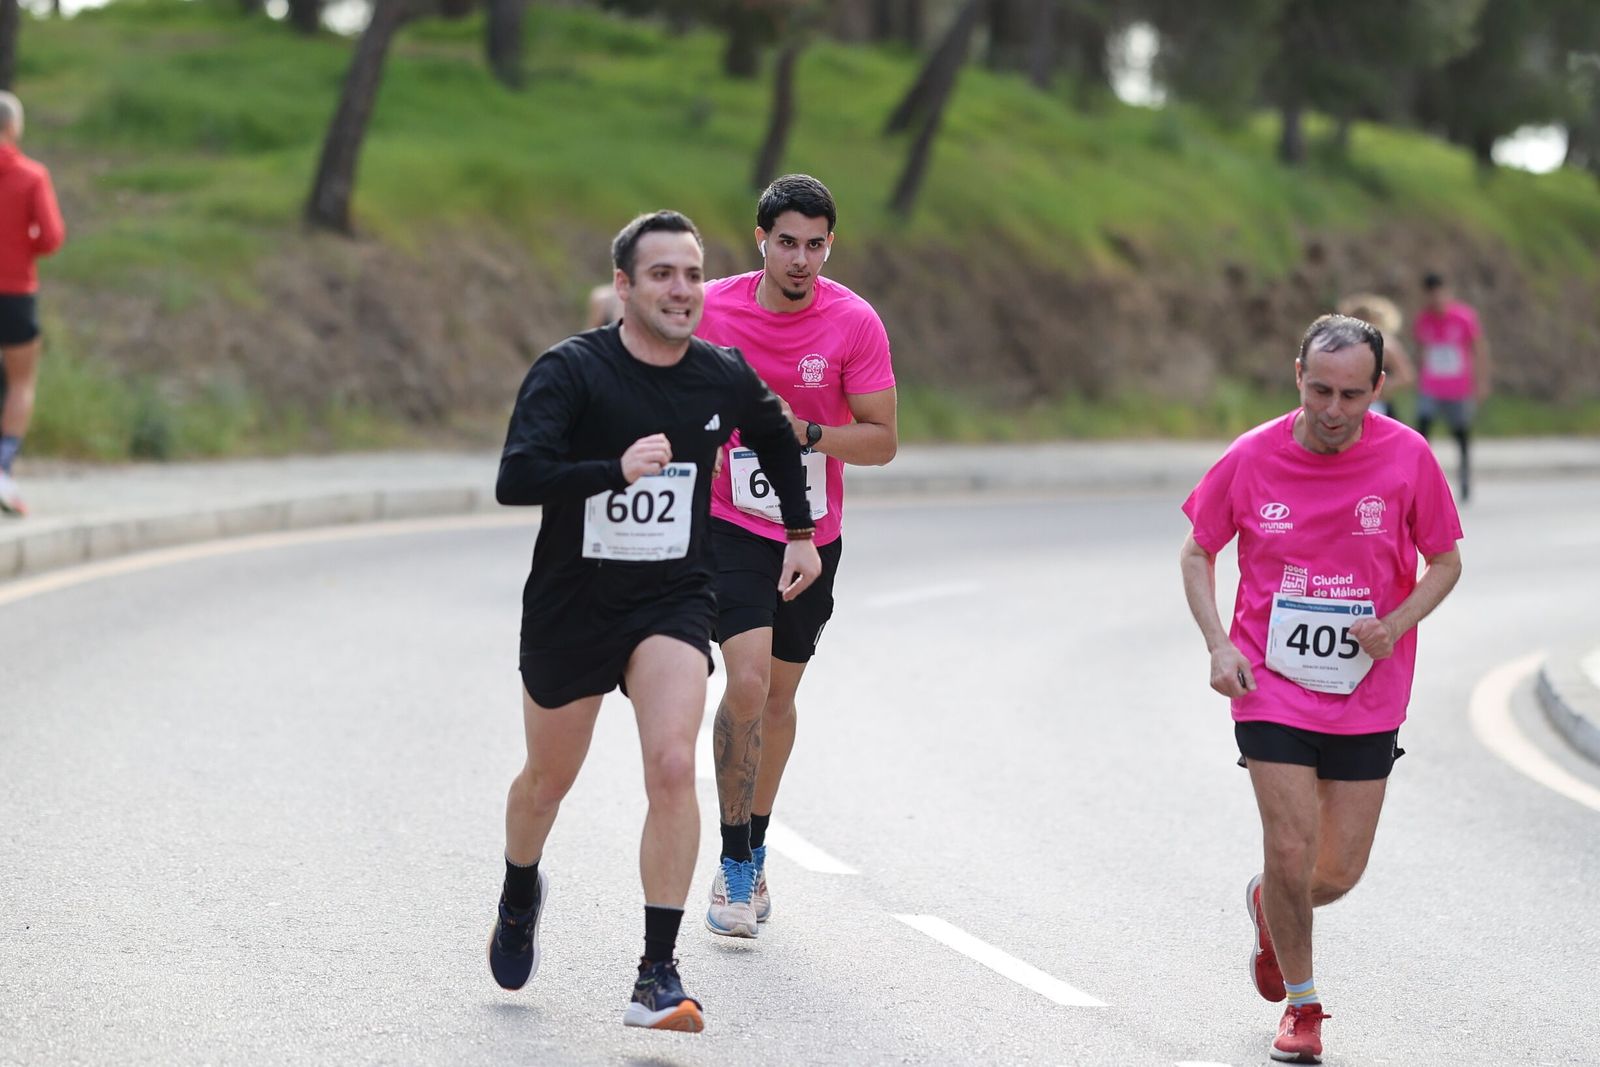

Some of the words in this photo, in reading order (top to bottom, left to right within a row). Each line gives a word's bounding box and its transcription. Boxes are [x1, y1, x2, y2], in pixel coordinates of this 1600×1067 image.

[749, 465, 812, 499] 61
[606, 490, 675, 523] 602
[1312, 574, 1353, 586] Ciudad
[1313, 588, 1328, 597] de
[1330, 587, 1370, 598] Málaga
[1286, 623, 1360, 659] 405
